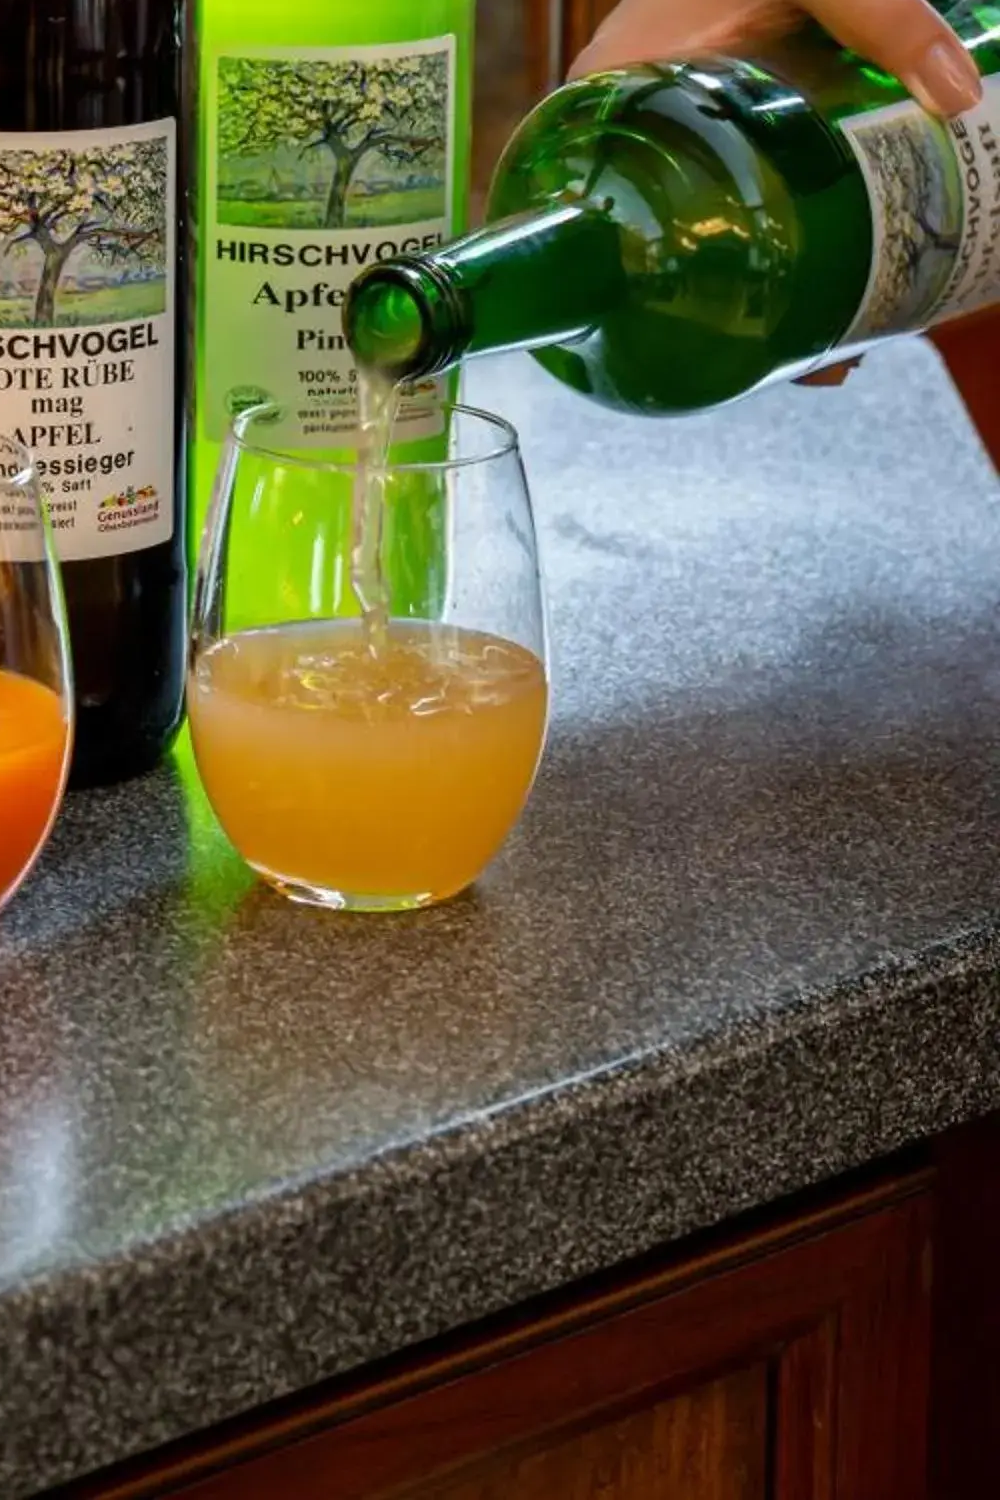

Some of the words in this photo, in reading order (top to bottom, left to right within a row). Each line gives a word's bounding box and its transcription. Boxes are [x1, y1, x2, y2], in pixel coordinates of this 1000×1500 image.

[62, 359, 136, 389] RÜBE
[298, 369, 340, 384] 100%
[31, 395, 83, 418] mag
[12, 422, 101, 448] APFEL
[62, 479, 91, 493] Saft
